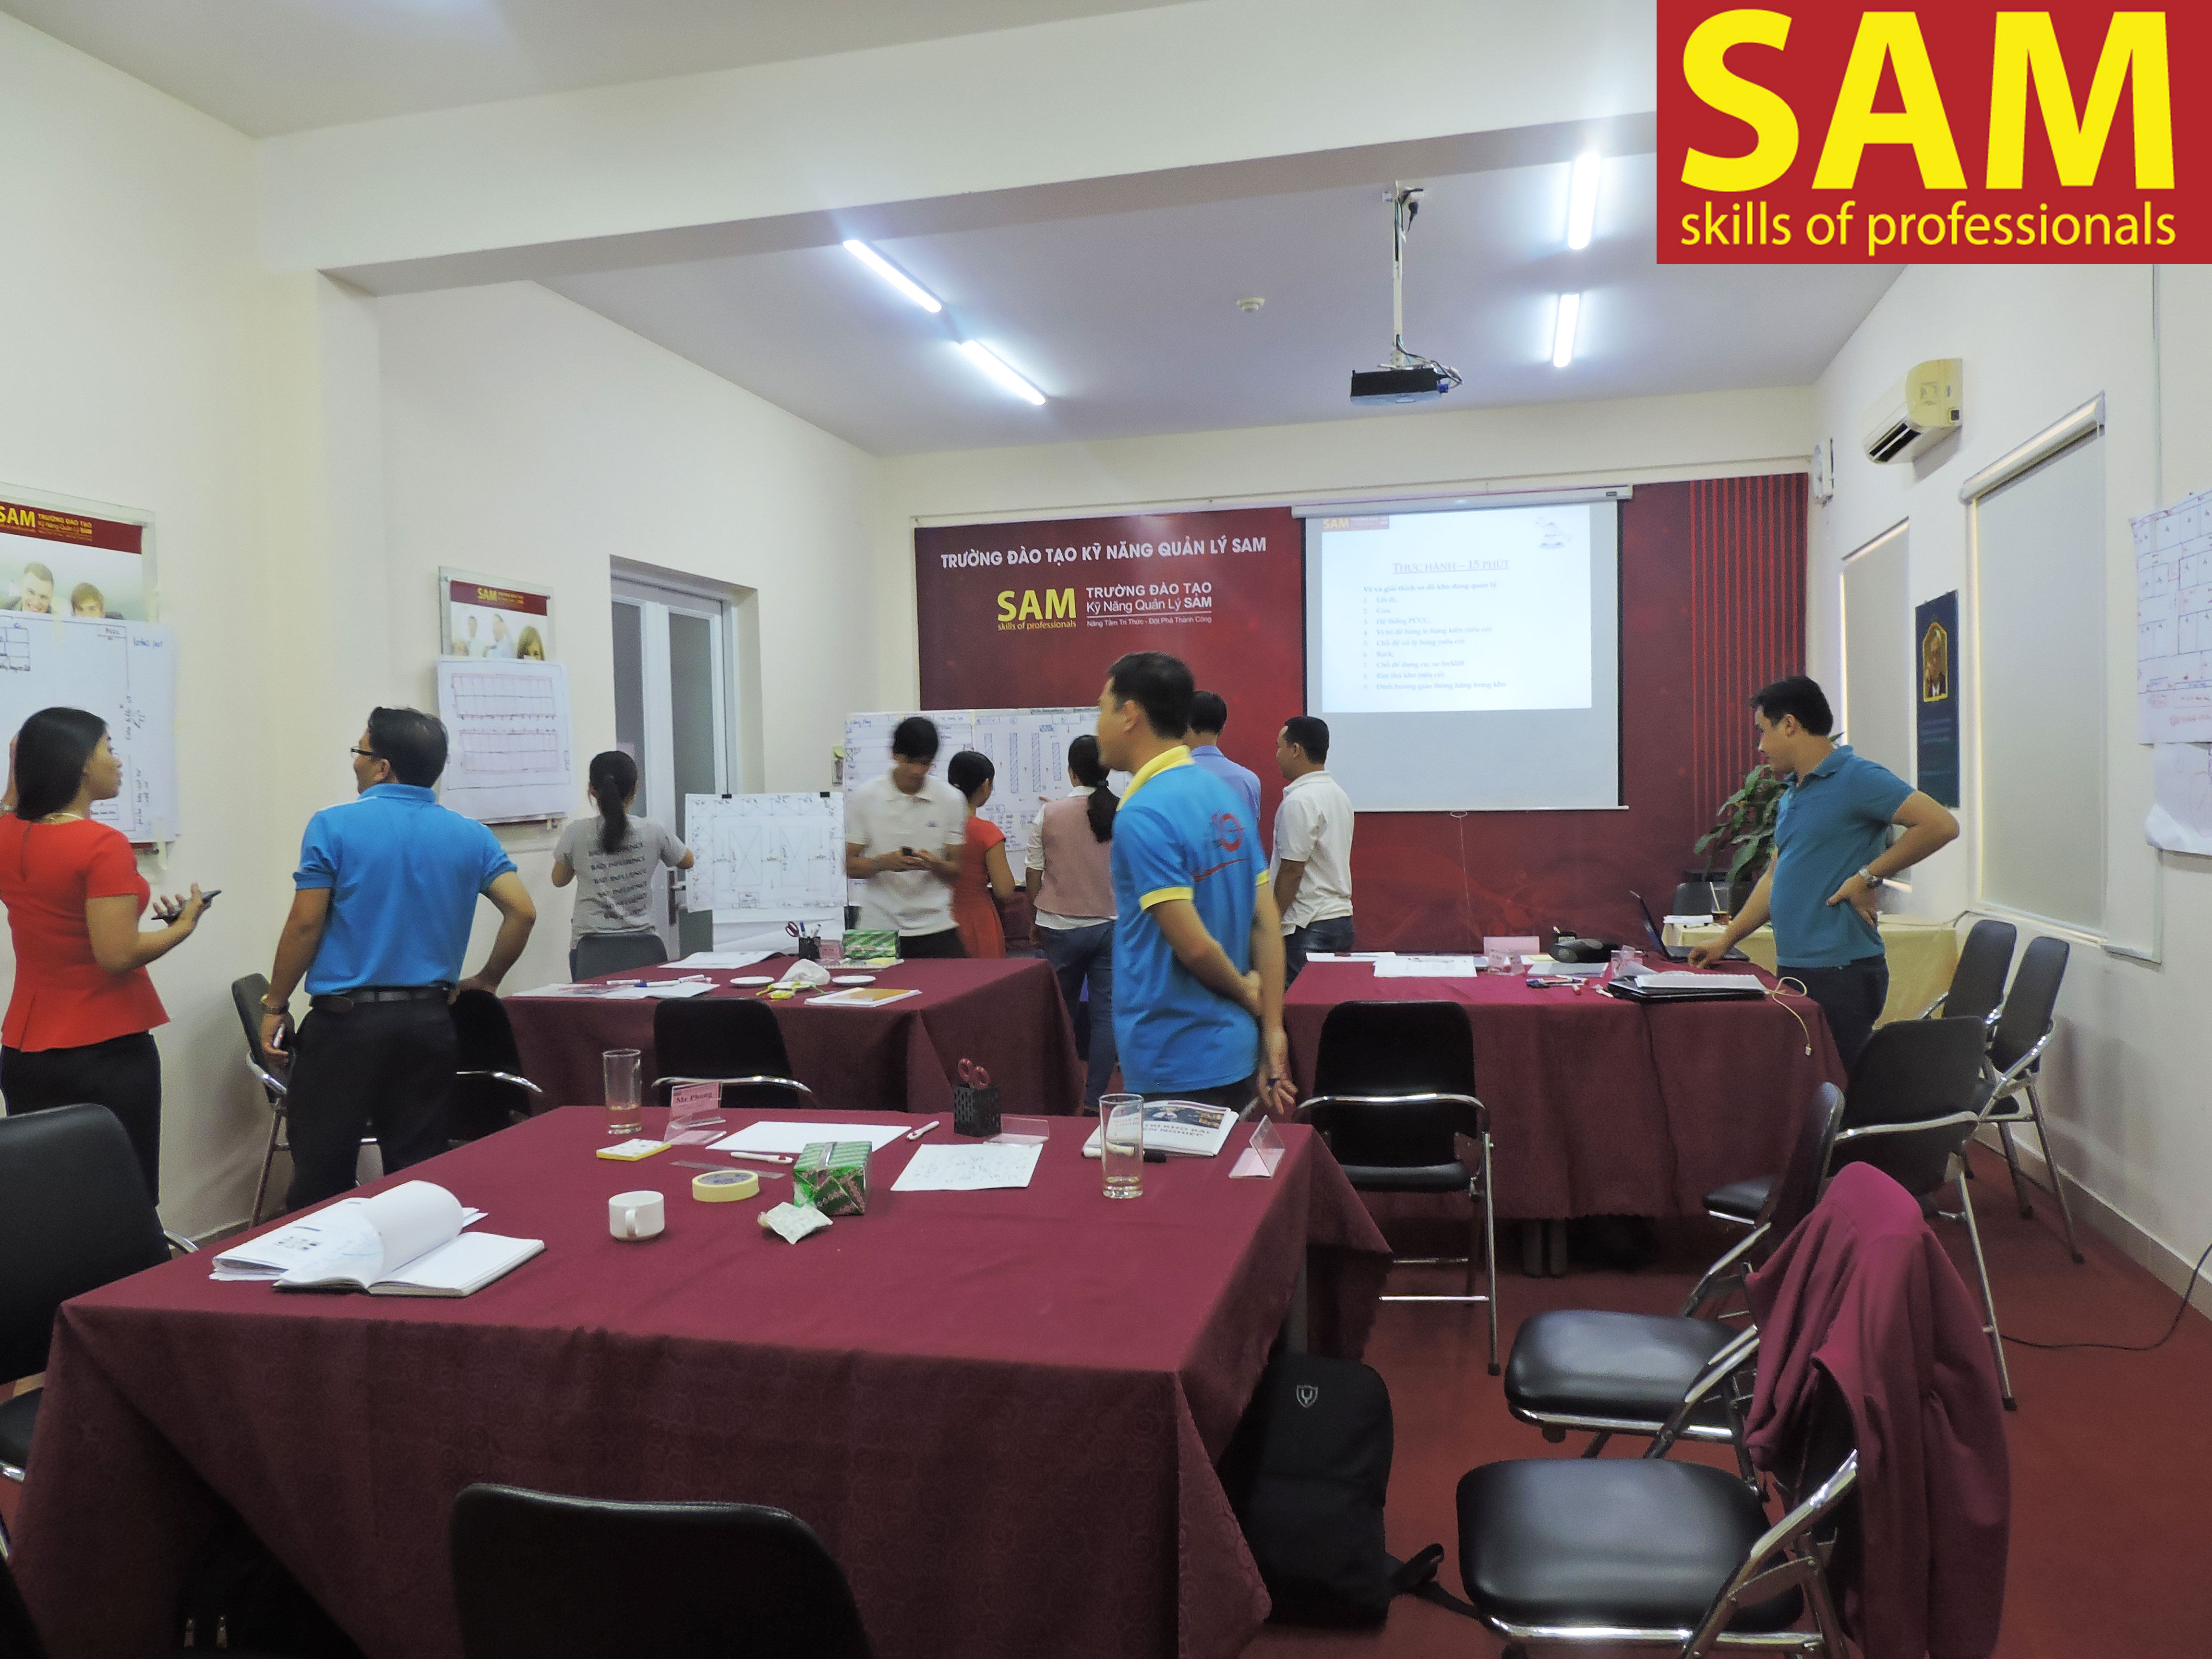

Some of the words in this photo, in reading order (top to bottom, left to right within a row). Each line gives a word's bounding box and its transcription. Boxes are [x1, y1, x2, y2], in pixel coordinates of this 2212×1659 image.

[1323, 518, 1349, 529] SAM
[941, 549, 1002, 568] TRƯỜNG
[1007, 545, 1042, 565] ĐÀO
[1045, 547, 1077, 566] TẠO
[1082, 542, 1102, 561] KỸ
[1106, 541, 1154, 559] NĂNG
[1158, 536, 1204, 556] QUẢN
[1210, 534, 1227, 554] LÝ
[1232, 537, 1266, 553] SAM
[1467, 559, 1479, 570] 15
[478, 588, 497, 601] SAM
[1086, 584, 1145, 599] TRƯỜNG
[1150, 581, 1179, 595] ĐÀO
[1183, 582, 1212, 597] TẠO
[998, 588, 1076, 622] SAM
[1086, 601, 1101, 614] Kỹ
[1104, 601, 1132, 613] Năng
[1135, 598, 1165, 611] Quản
[1168, 598, 1181, 611] Lý
[1184, 597, 1212, 608] SAM
[998, 623, 1016, 631] skills
[1017, 621, 1025, 630] of
[1027, 620, 1076, 631] professionals
